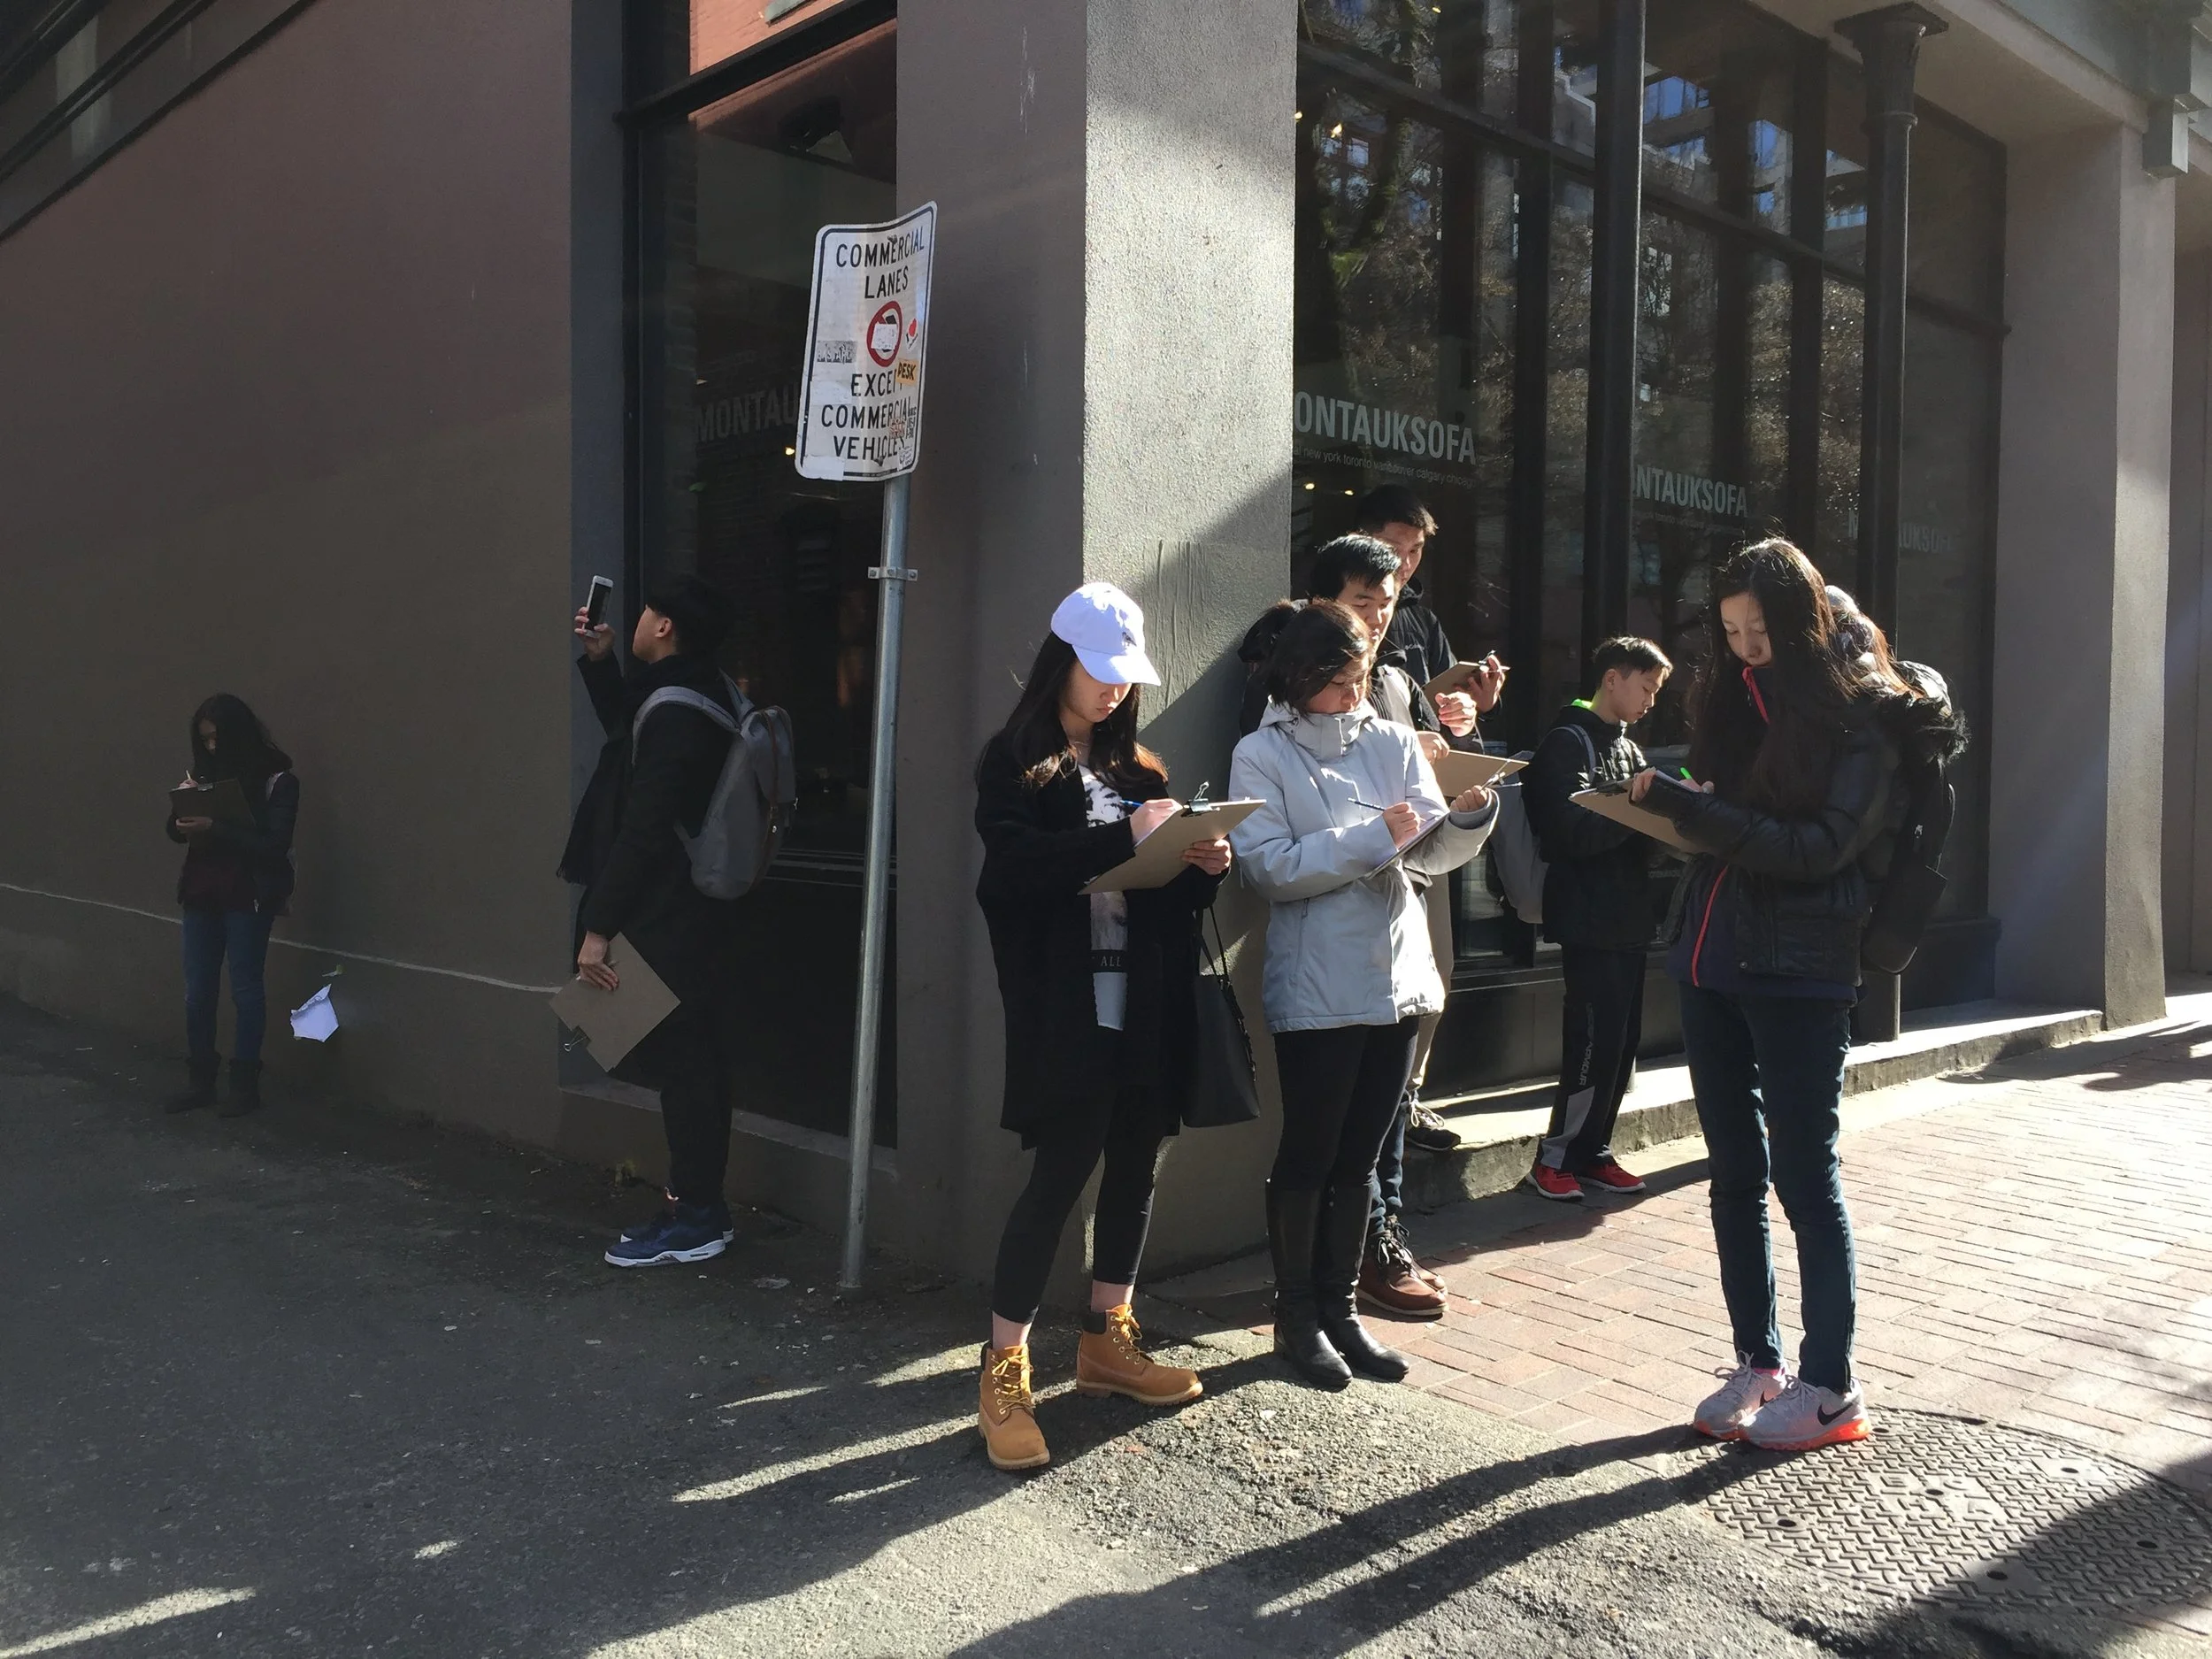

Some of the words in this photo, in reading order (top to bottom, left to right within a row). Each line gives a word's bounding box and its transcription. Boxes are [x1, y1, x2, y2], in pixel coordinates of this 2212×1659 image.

[836, 226, 925, 268] COMMERCIAL
[864, 265, 909, 299] LANES
[851, 367, 902, 396] EXCE
[695, 381, 798, 442] MONTAU
[1294, 391, 1477, 466] ONTAUKSOFA
[1303, 448, 1322, 459] new
[1323, 451, 1341, 464] york
[1343, 453, 1372, 469] toronto
[1416, 466, 1445, 485] calgary
[1634, 465, 1748, 518] NTAUKSOFA
